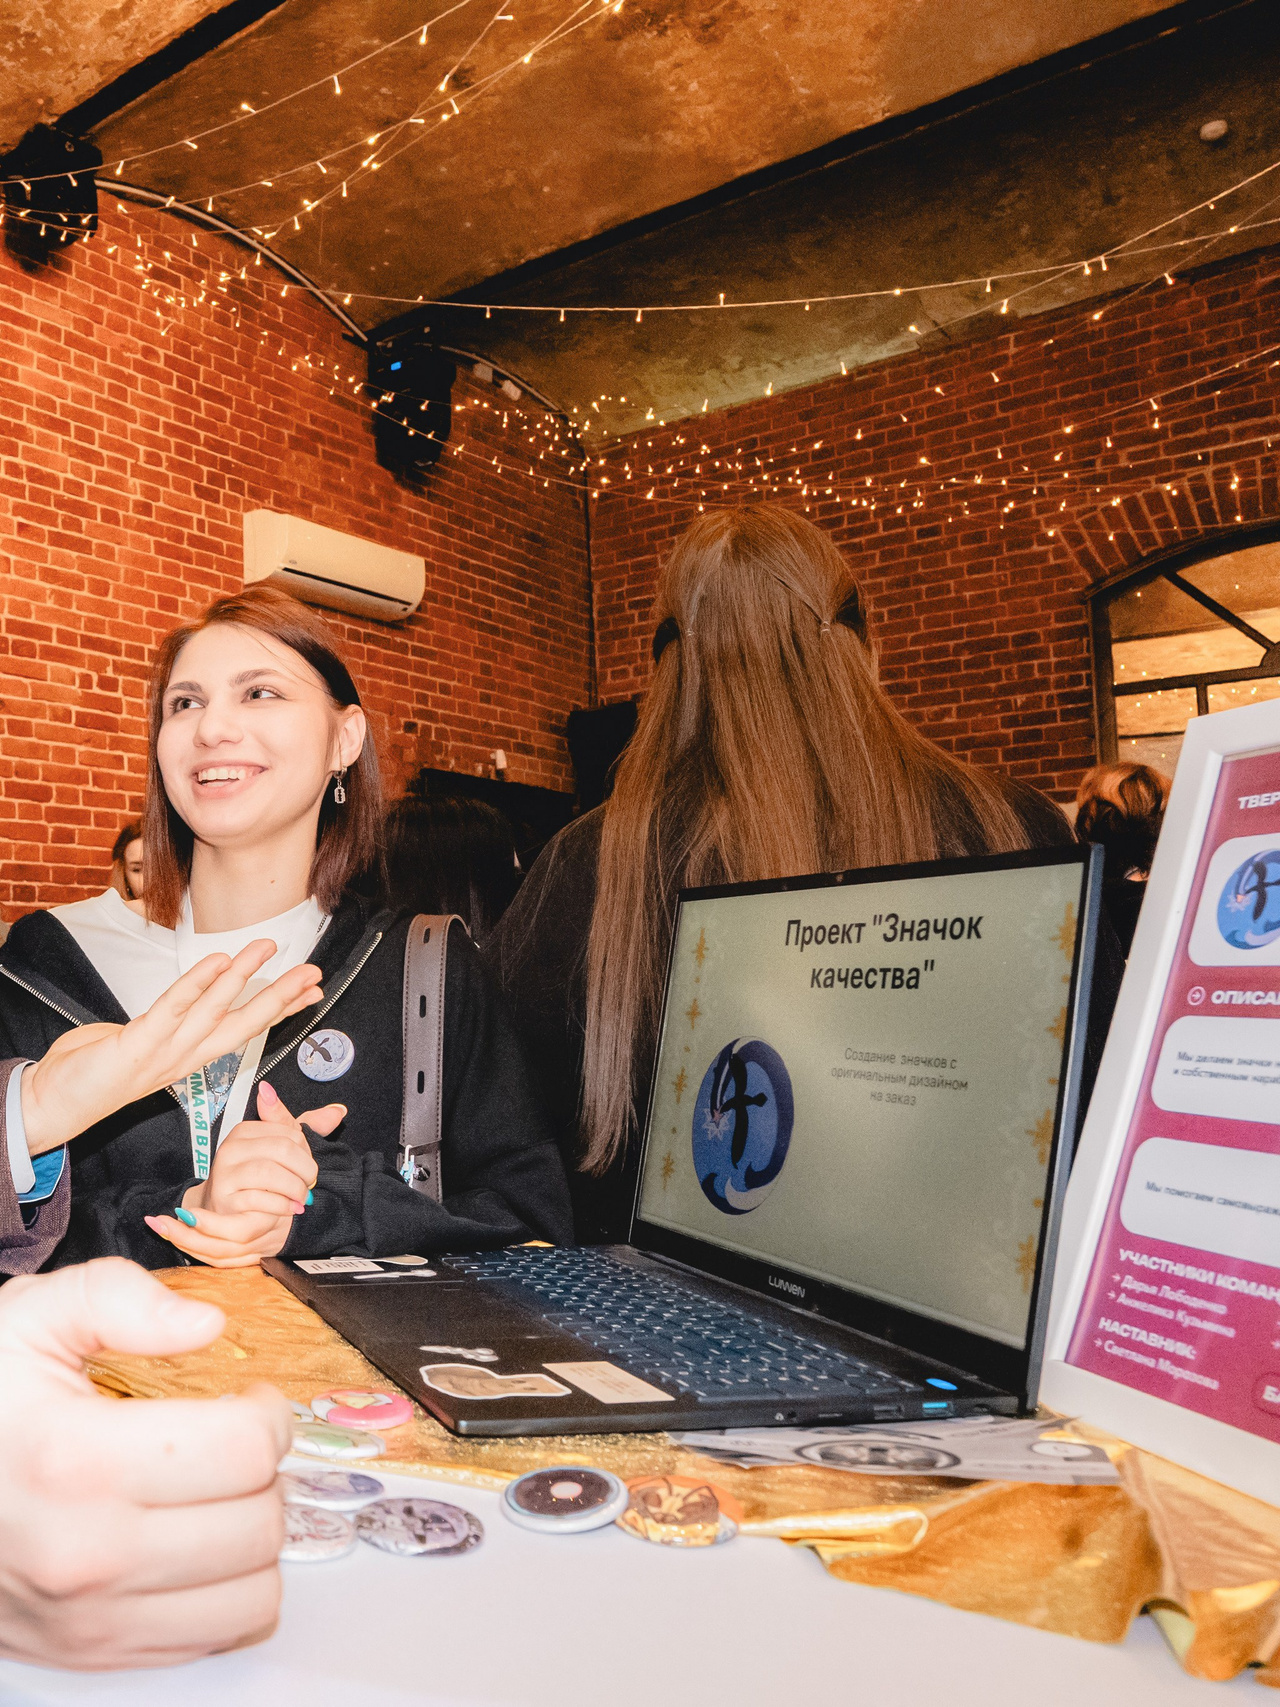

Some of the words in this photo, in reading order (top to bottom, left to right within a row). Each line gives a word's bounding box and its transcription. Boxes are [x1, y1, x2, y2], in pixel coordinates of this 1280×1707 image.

[1238, 791, 1280, 810] ТВЕР
[785, 919, 866, 952] Проект
[873, 913, 984, 943] "Значок
[810, 959, 935, 990] качества"
[844, 1047, 896, 1064] Создание
[900, 1054, 947, 1069] значков
[950, 1058, 958, 1069] с
[831, 1067, 907, 1084] оригинальным
[908, 1075, 969, 1091] дизайном
[870, 1091, 883, 1102] на
[885, 1093, 917, 1106] заказ
[196, 1136, 209, 1147] В
[1119, 1248, 1216, 1285] УЧАСТНИКИ
